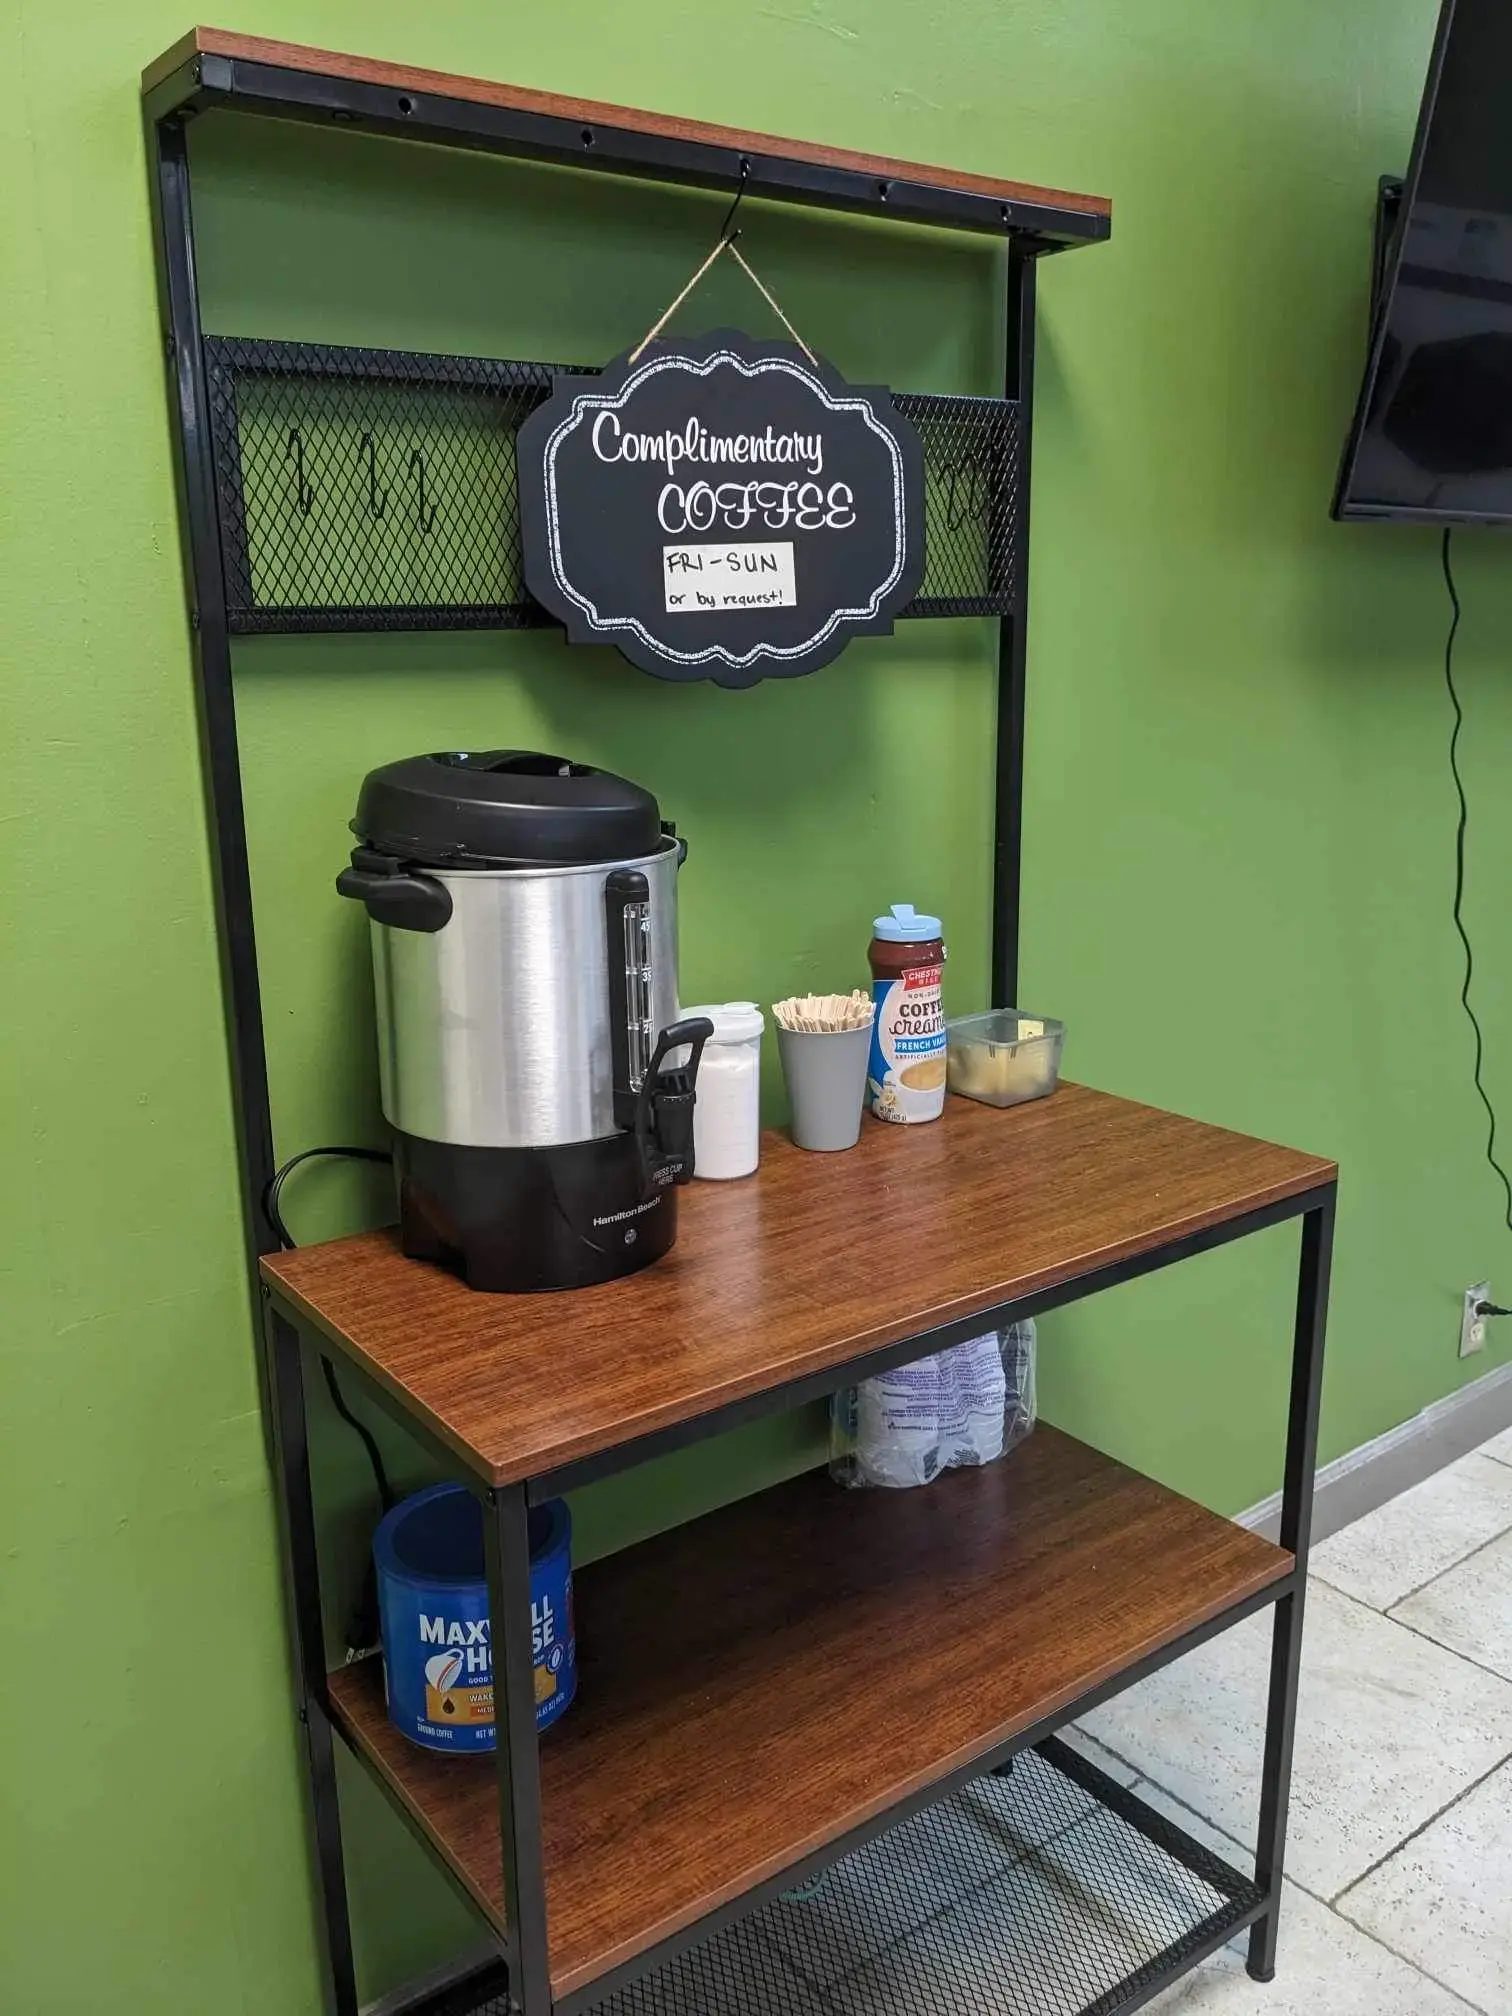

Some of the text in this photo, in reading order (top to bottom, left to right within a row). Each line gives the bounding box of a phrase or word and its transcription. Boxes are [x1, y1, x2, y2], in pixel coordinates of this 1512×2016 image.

[592, 411, 823, 475] Complimentary
[657, 481, 856, 533] COFFEE
[729, 552, 778, 573] SUN
[669, 589, 783, 607] or by request!
[897, 1039, 931, 1051] FRENCH
[593, 1196, 660, 1227] Hamilton Beach
[468, 1676, 489, 1686] GOOD
